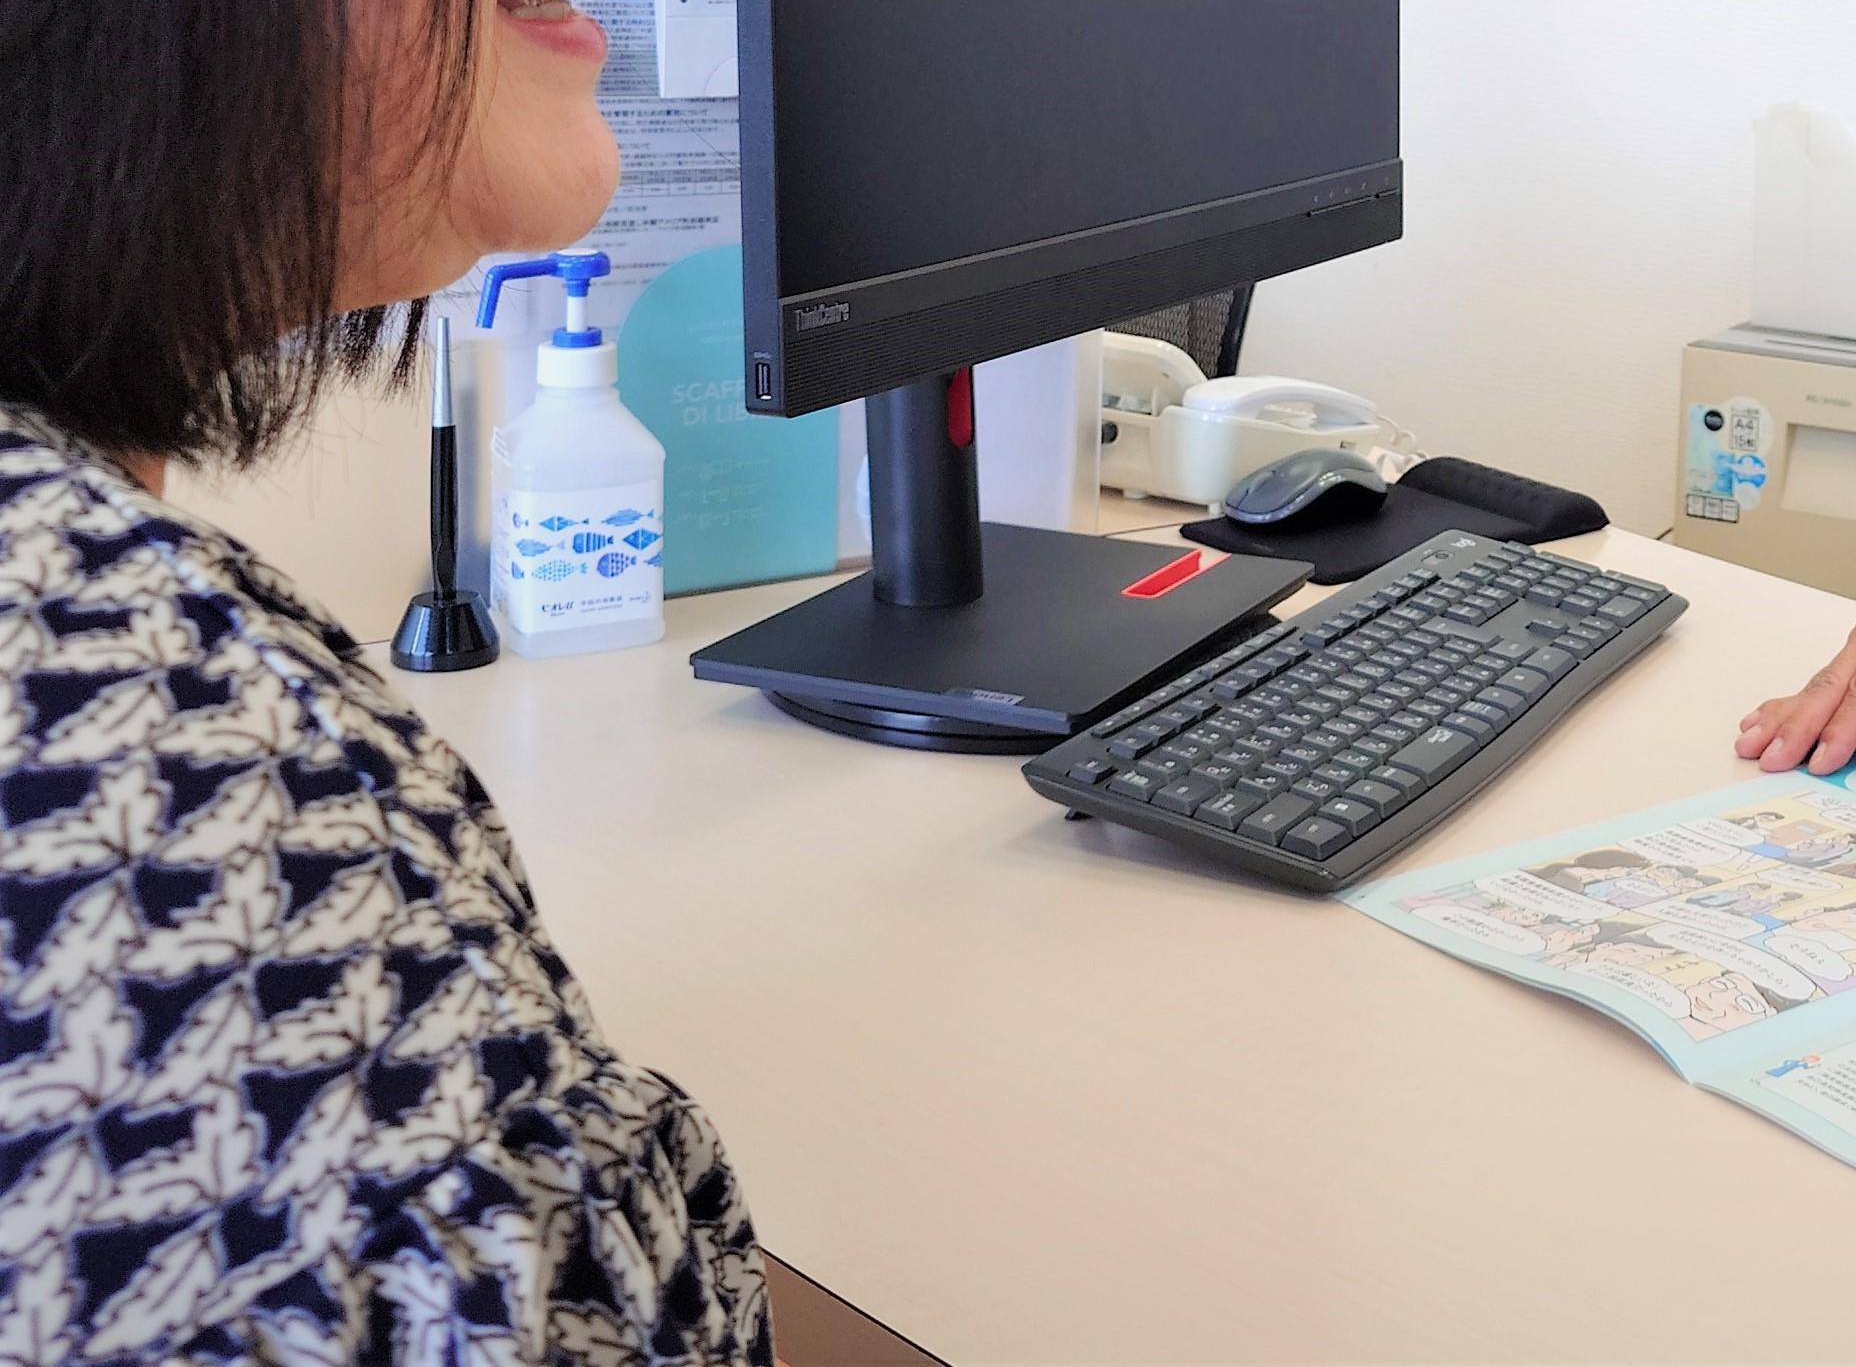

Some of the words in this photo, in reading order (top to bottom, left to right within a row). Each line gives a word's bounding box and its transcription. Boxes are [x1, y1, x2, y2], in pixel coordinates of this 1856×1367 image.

[672, 379, 744, 404] SCAFF
[716, 402, 758, 424] LIB
[1735, 418, 1754, 431] A4
